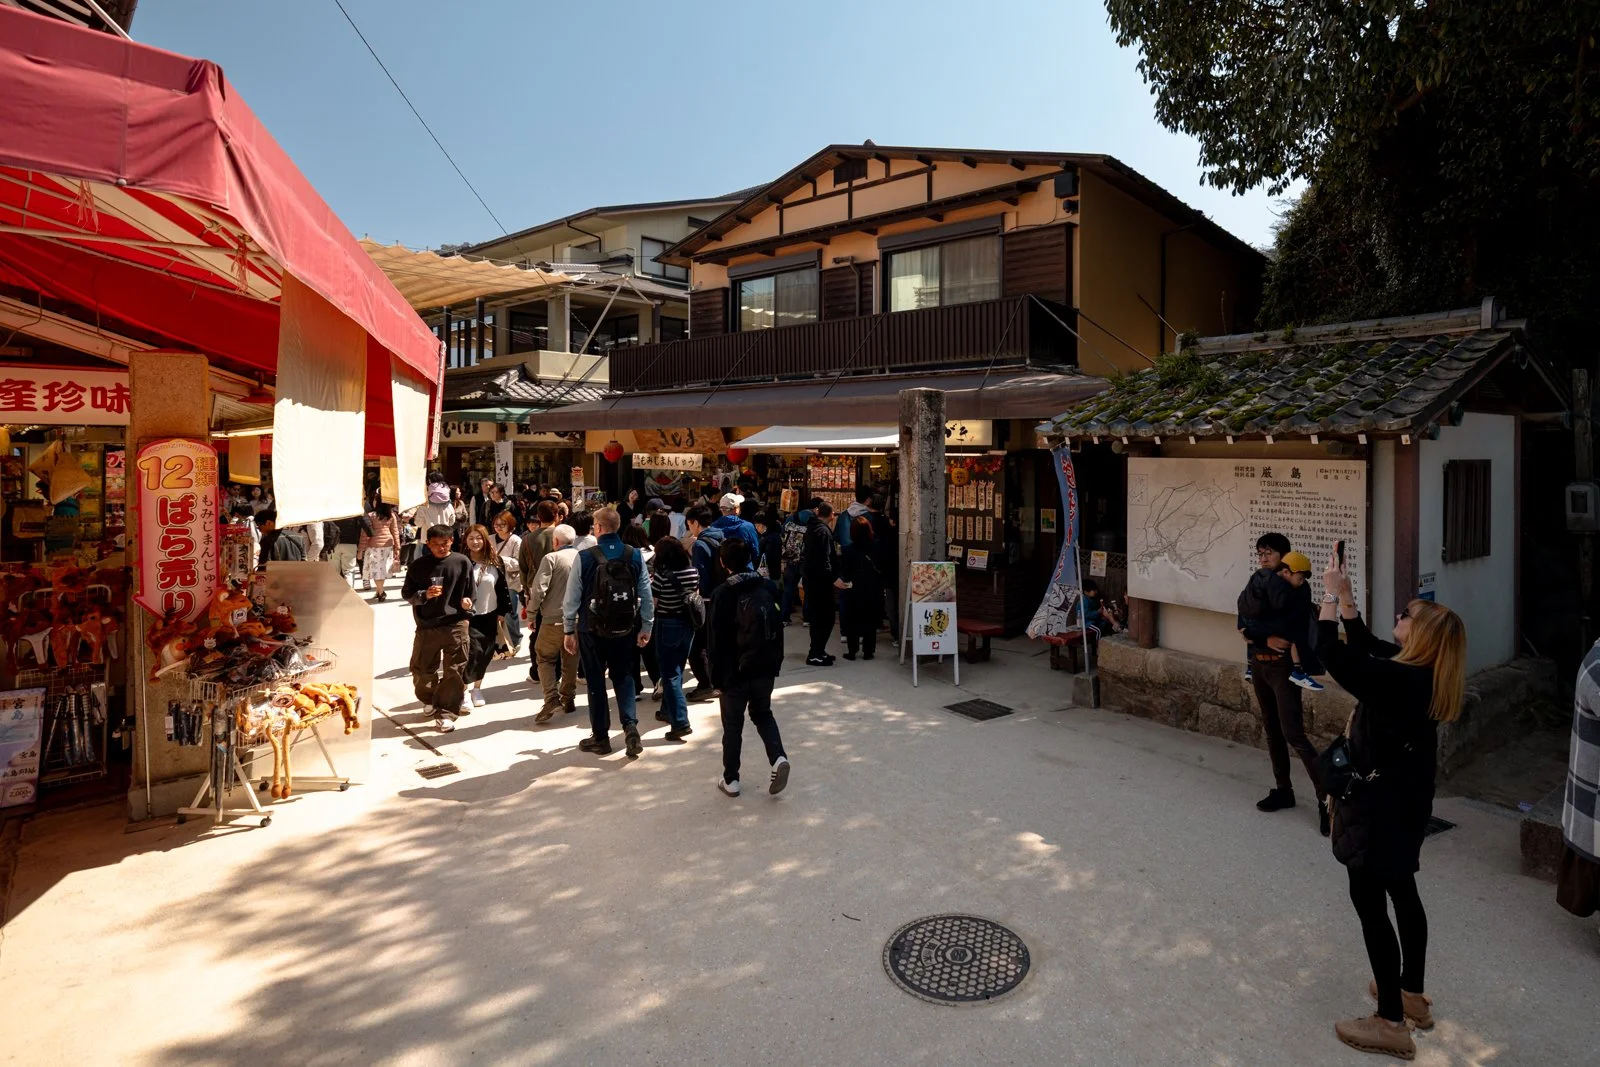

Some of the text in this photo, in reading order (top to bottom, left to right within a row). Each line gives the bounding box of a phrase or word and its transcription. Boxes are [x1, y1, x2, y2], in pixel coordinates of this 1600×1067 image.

[139, 455, 193, 490] 12
[194, 456, 217, 488] 種類
[640, 456, 696, 468] もみじまんじゅう
[1260, 480, 1303, 489] ITSUKUSHIMA
[156, 493, 198, 623] ばら売り
[201, 494, 216, 597] もみじまんじゅう
